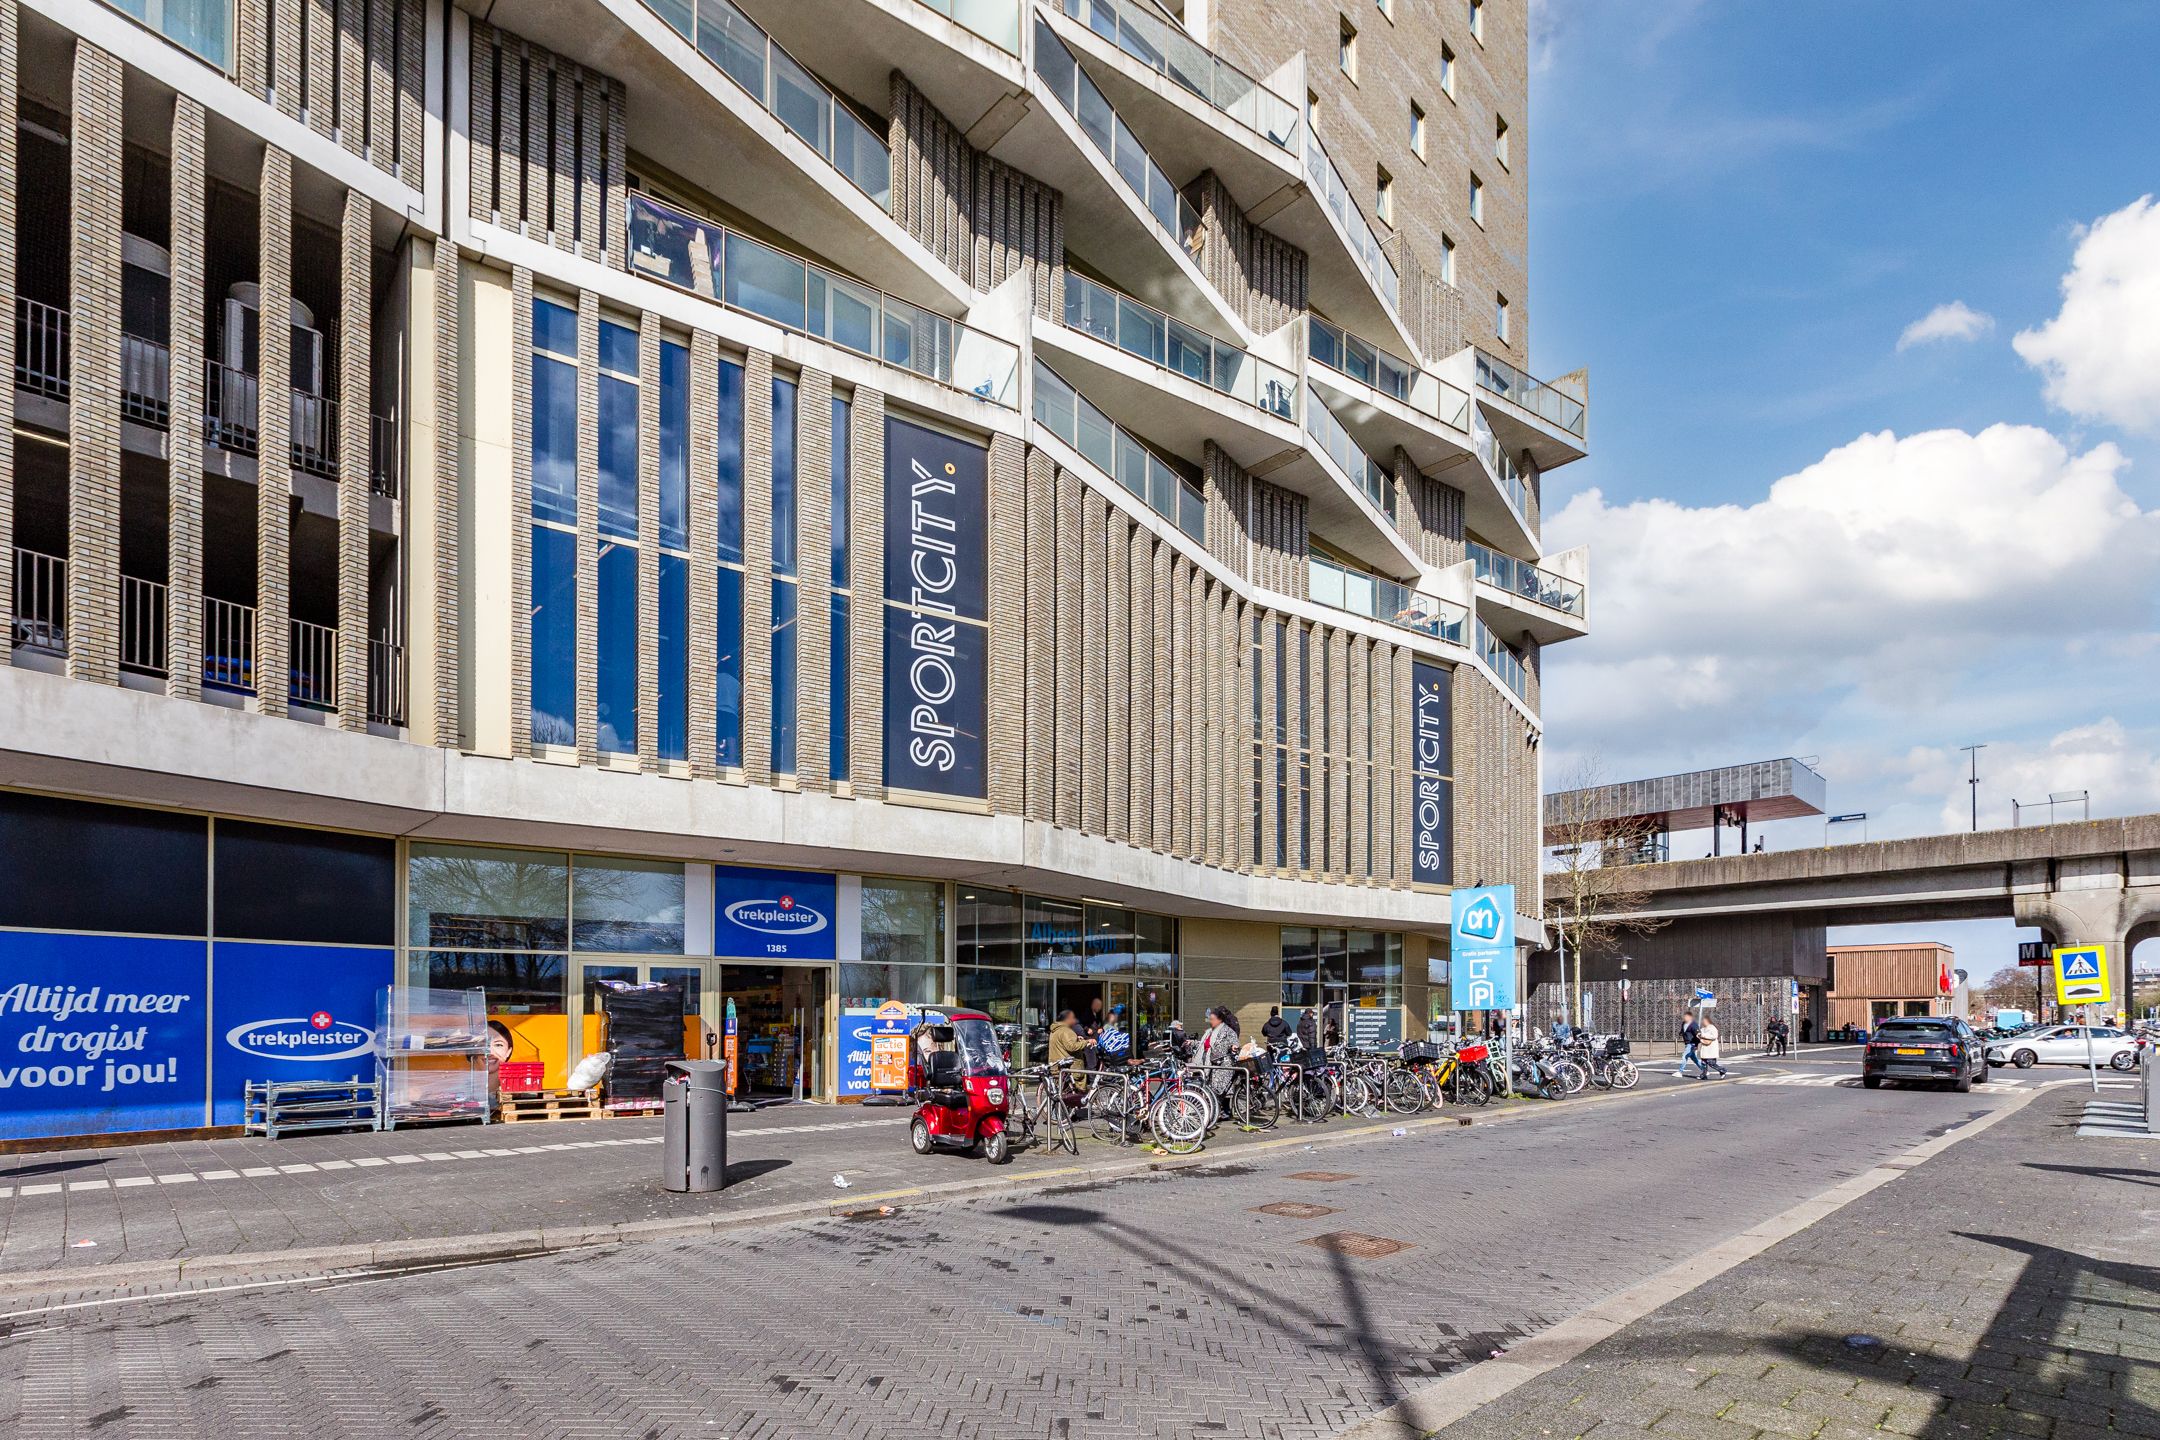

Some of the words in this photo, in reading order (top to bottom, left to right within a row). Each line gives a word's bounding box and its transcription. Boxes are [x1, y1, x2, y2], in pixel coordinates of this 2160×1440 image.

[738, 909, 813, 923] trekpleister
[1031, 921, 1077, 945] Albert
[766, 944, 787, 953] 1385
[2021, 943, 2036, 959] M
[0, 983, 101, 1022] Altijd
[103, 993, 191, 1014] meer
[18, 1024, 149, 1060] drogist
[247, 1030, 362, 1049] trekpleister
[0, 1065, 94, 1089] voor
[101, 1057, 178, 1092] jou!
[853, 1065, 872, 1077] dro
[847, 1080, 872, 1090] voo
